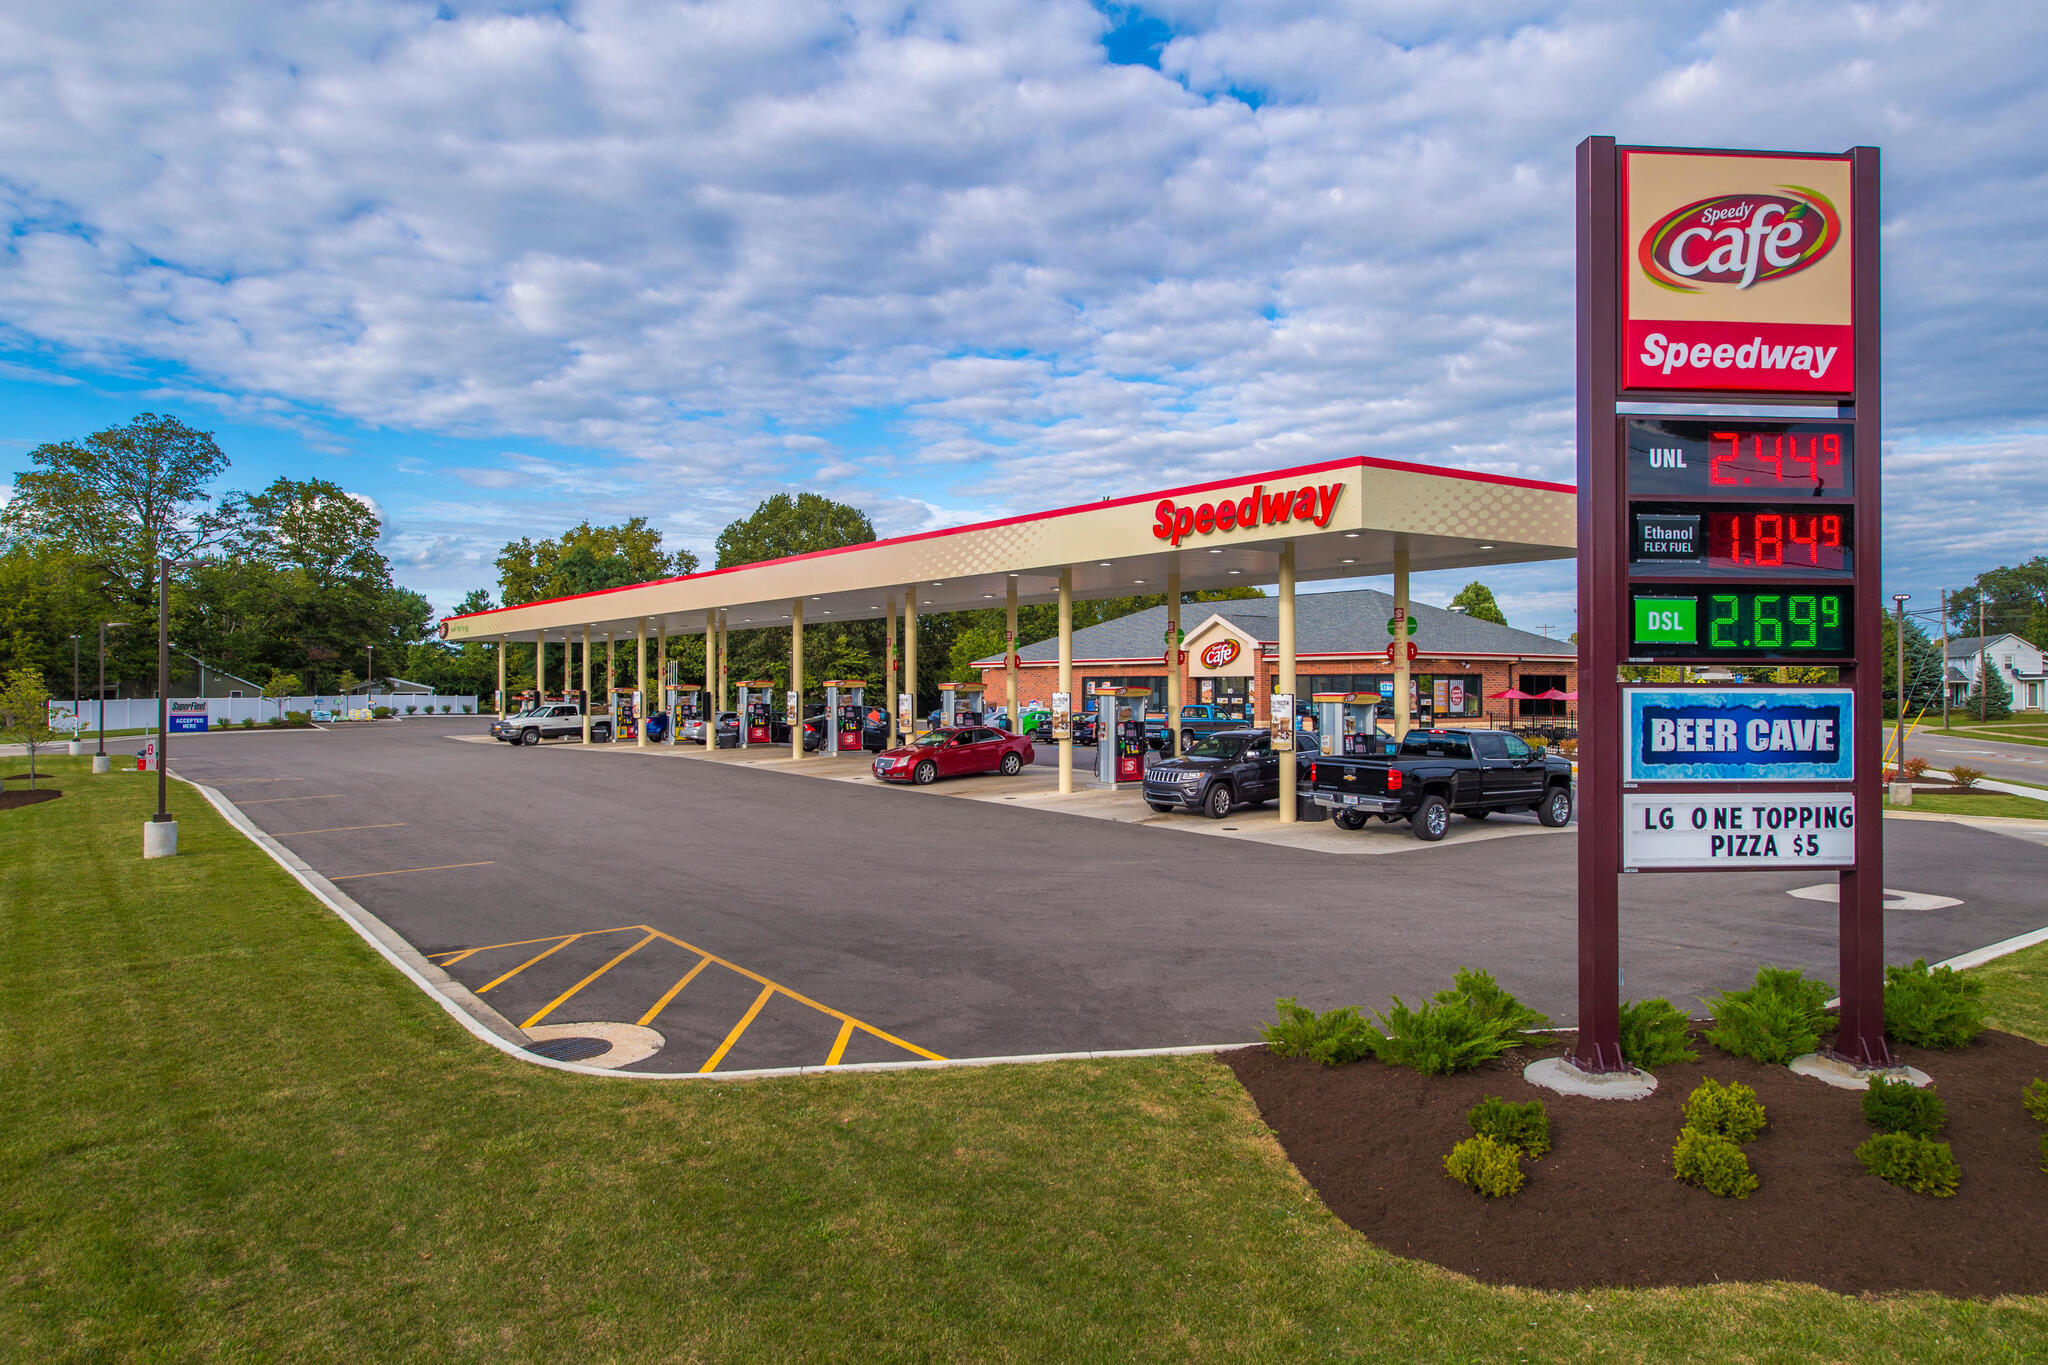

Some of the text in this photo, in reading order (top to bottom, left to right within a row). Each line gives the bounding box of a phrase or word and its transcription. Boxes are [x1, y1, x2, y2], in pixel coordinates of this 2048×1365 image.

[1701, 201, 1754, 226] Speedy
[1640, 332, 1838, 379] Speedway
[1649, 448, 1687, 468] UNL
[1152, 482, 1345, 546] Speedway
[1644, 525, 1693, 540] Ethanol
[1644, 542, 1693, 553] FLEX FUEL
[1648, 611, 1683, 631] DSL
[172, 701, 206, 712] SuperFleet
[1651, 718, 1834, 752] BEER CAVE
[1644, 806, 1853, 830] LG ONE TOPPING
[1711, 834, 1820, 857] PIZZA $5
